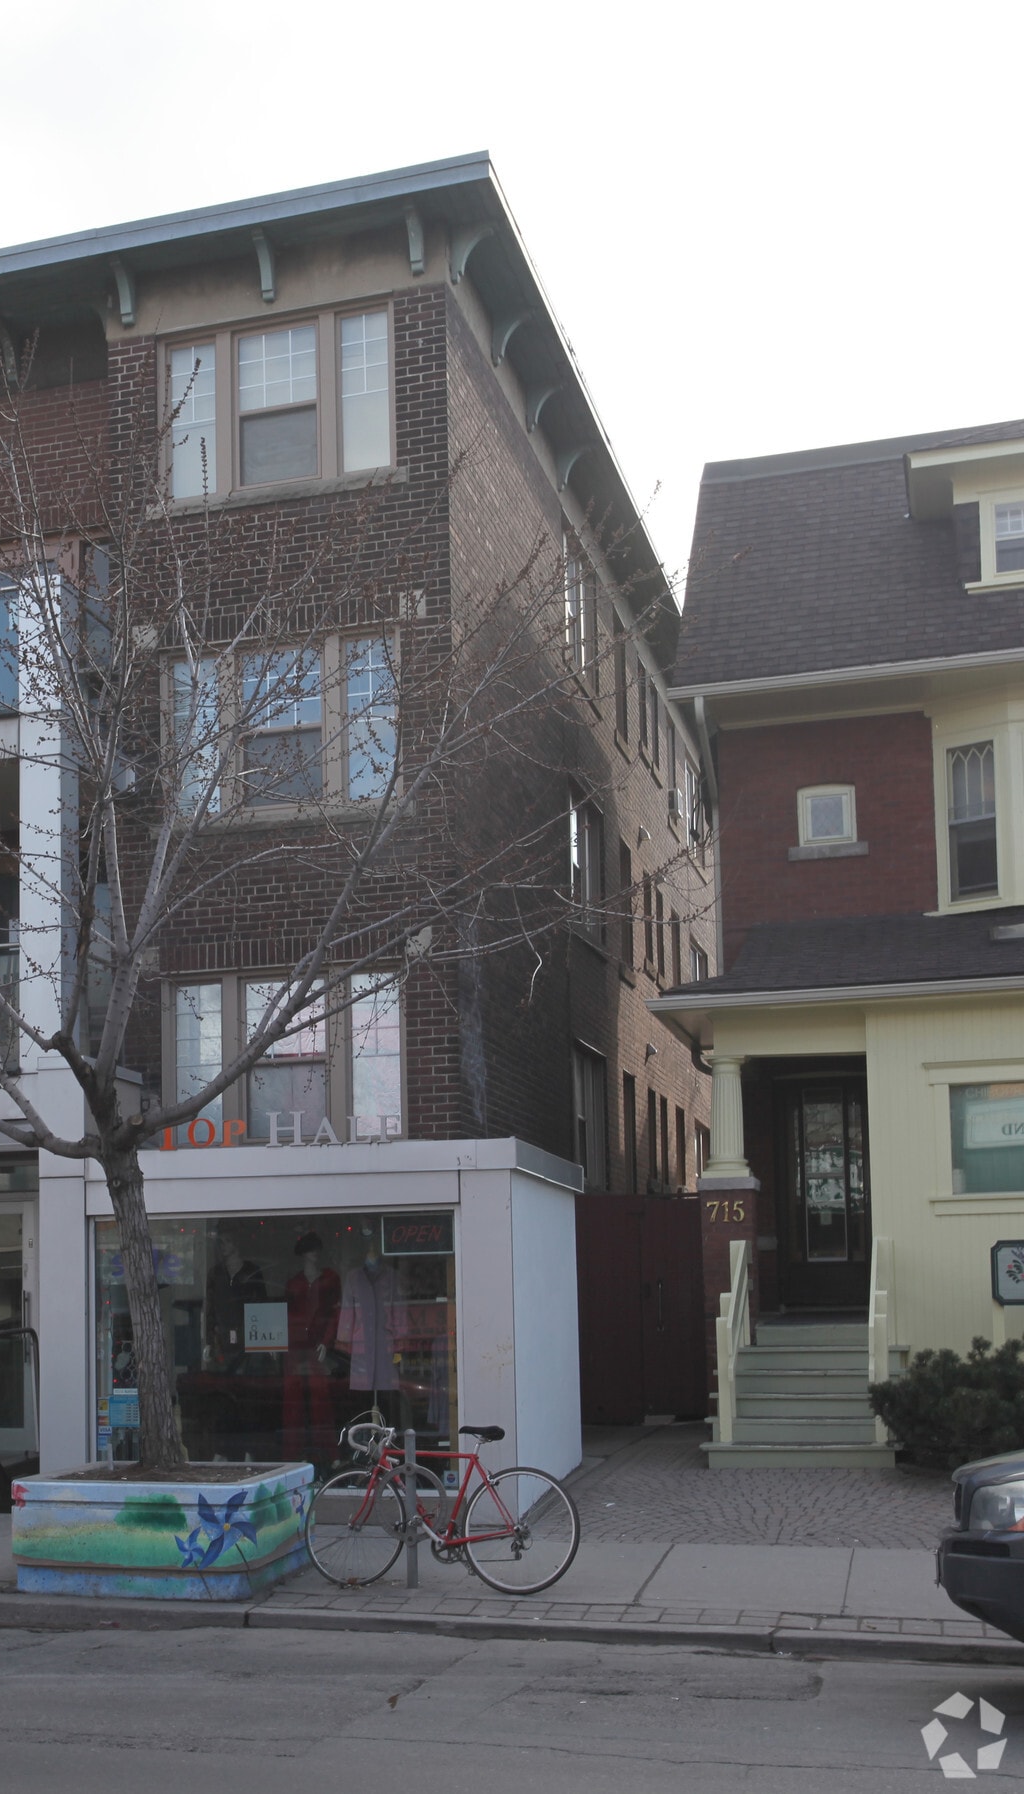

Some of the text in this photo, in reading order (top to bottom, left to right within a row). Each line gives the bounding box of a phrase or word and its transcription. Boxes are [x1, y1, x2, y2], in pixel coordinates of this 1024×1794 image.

[266, 1111, 401, 1148] HALF
[706, 1200, 745, 1223] 715
[392, 1224, 443, 1243] OPEN
[111, 1249, 182, 1278] sle
